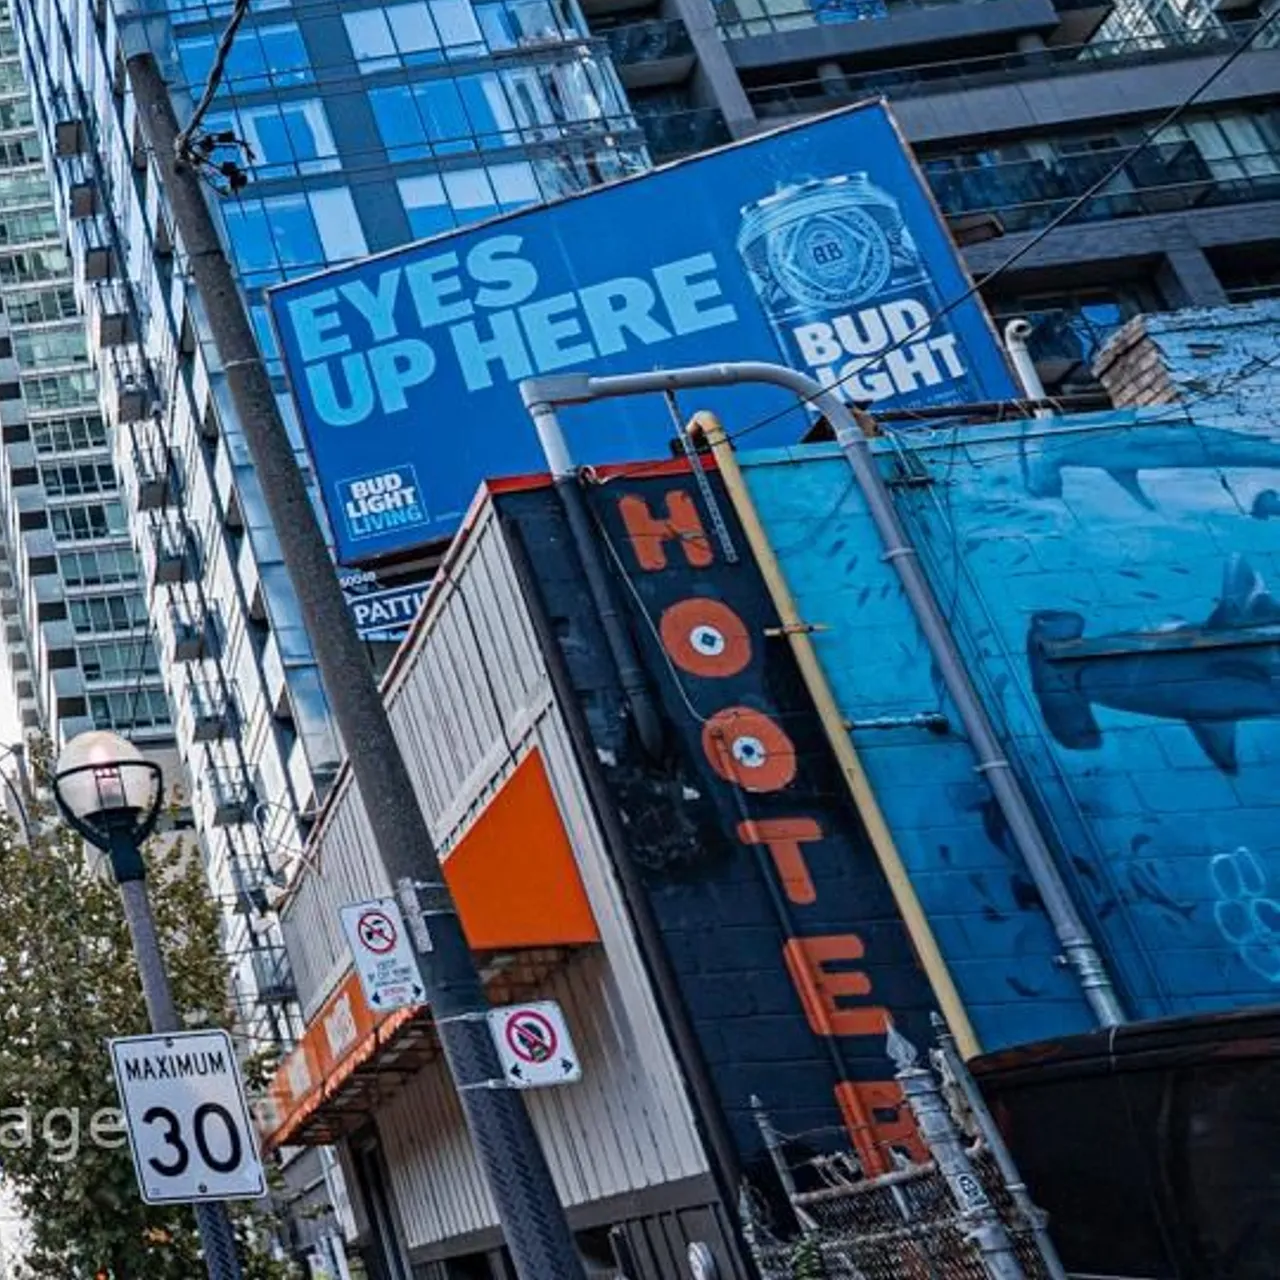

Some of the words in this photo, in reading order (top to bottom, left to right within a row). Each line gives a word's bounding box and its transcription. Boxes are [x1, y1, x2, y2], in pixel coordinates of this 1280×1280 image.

[287, 235, 538, 363] EYES
[304, 338, 436, 426] UP
[450, 252, 738, 392] HERE
[793, 298, 931, 366] BUD
[804, 332, 967, 411] IGHT
[346, 486, 415, 518] LIGHT
[350, 472, 402, 499] BUD
[351, 504, 423, 535] LIVING
[353, 592, 426, 625] PATTI
[124, 1051, 227, 1082] MAXIMUM
[142, 1102, 242, 1177] 30
